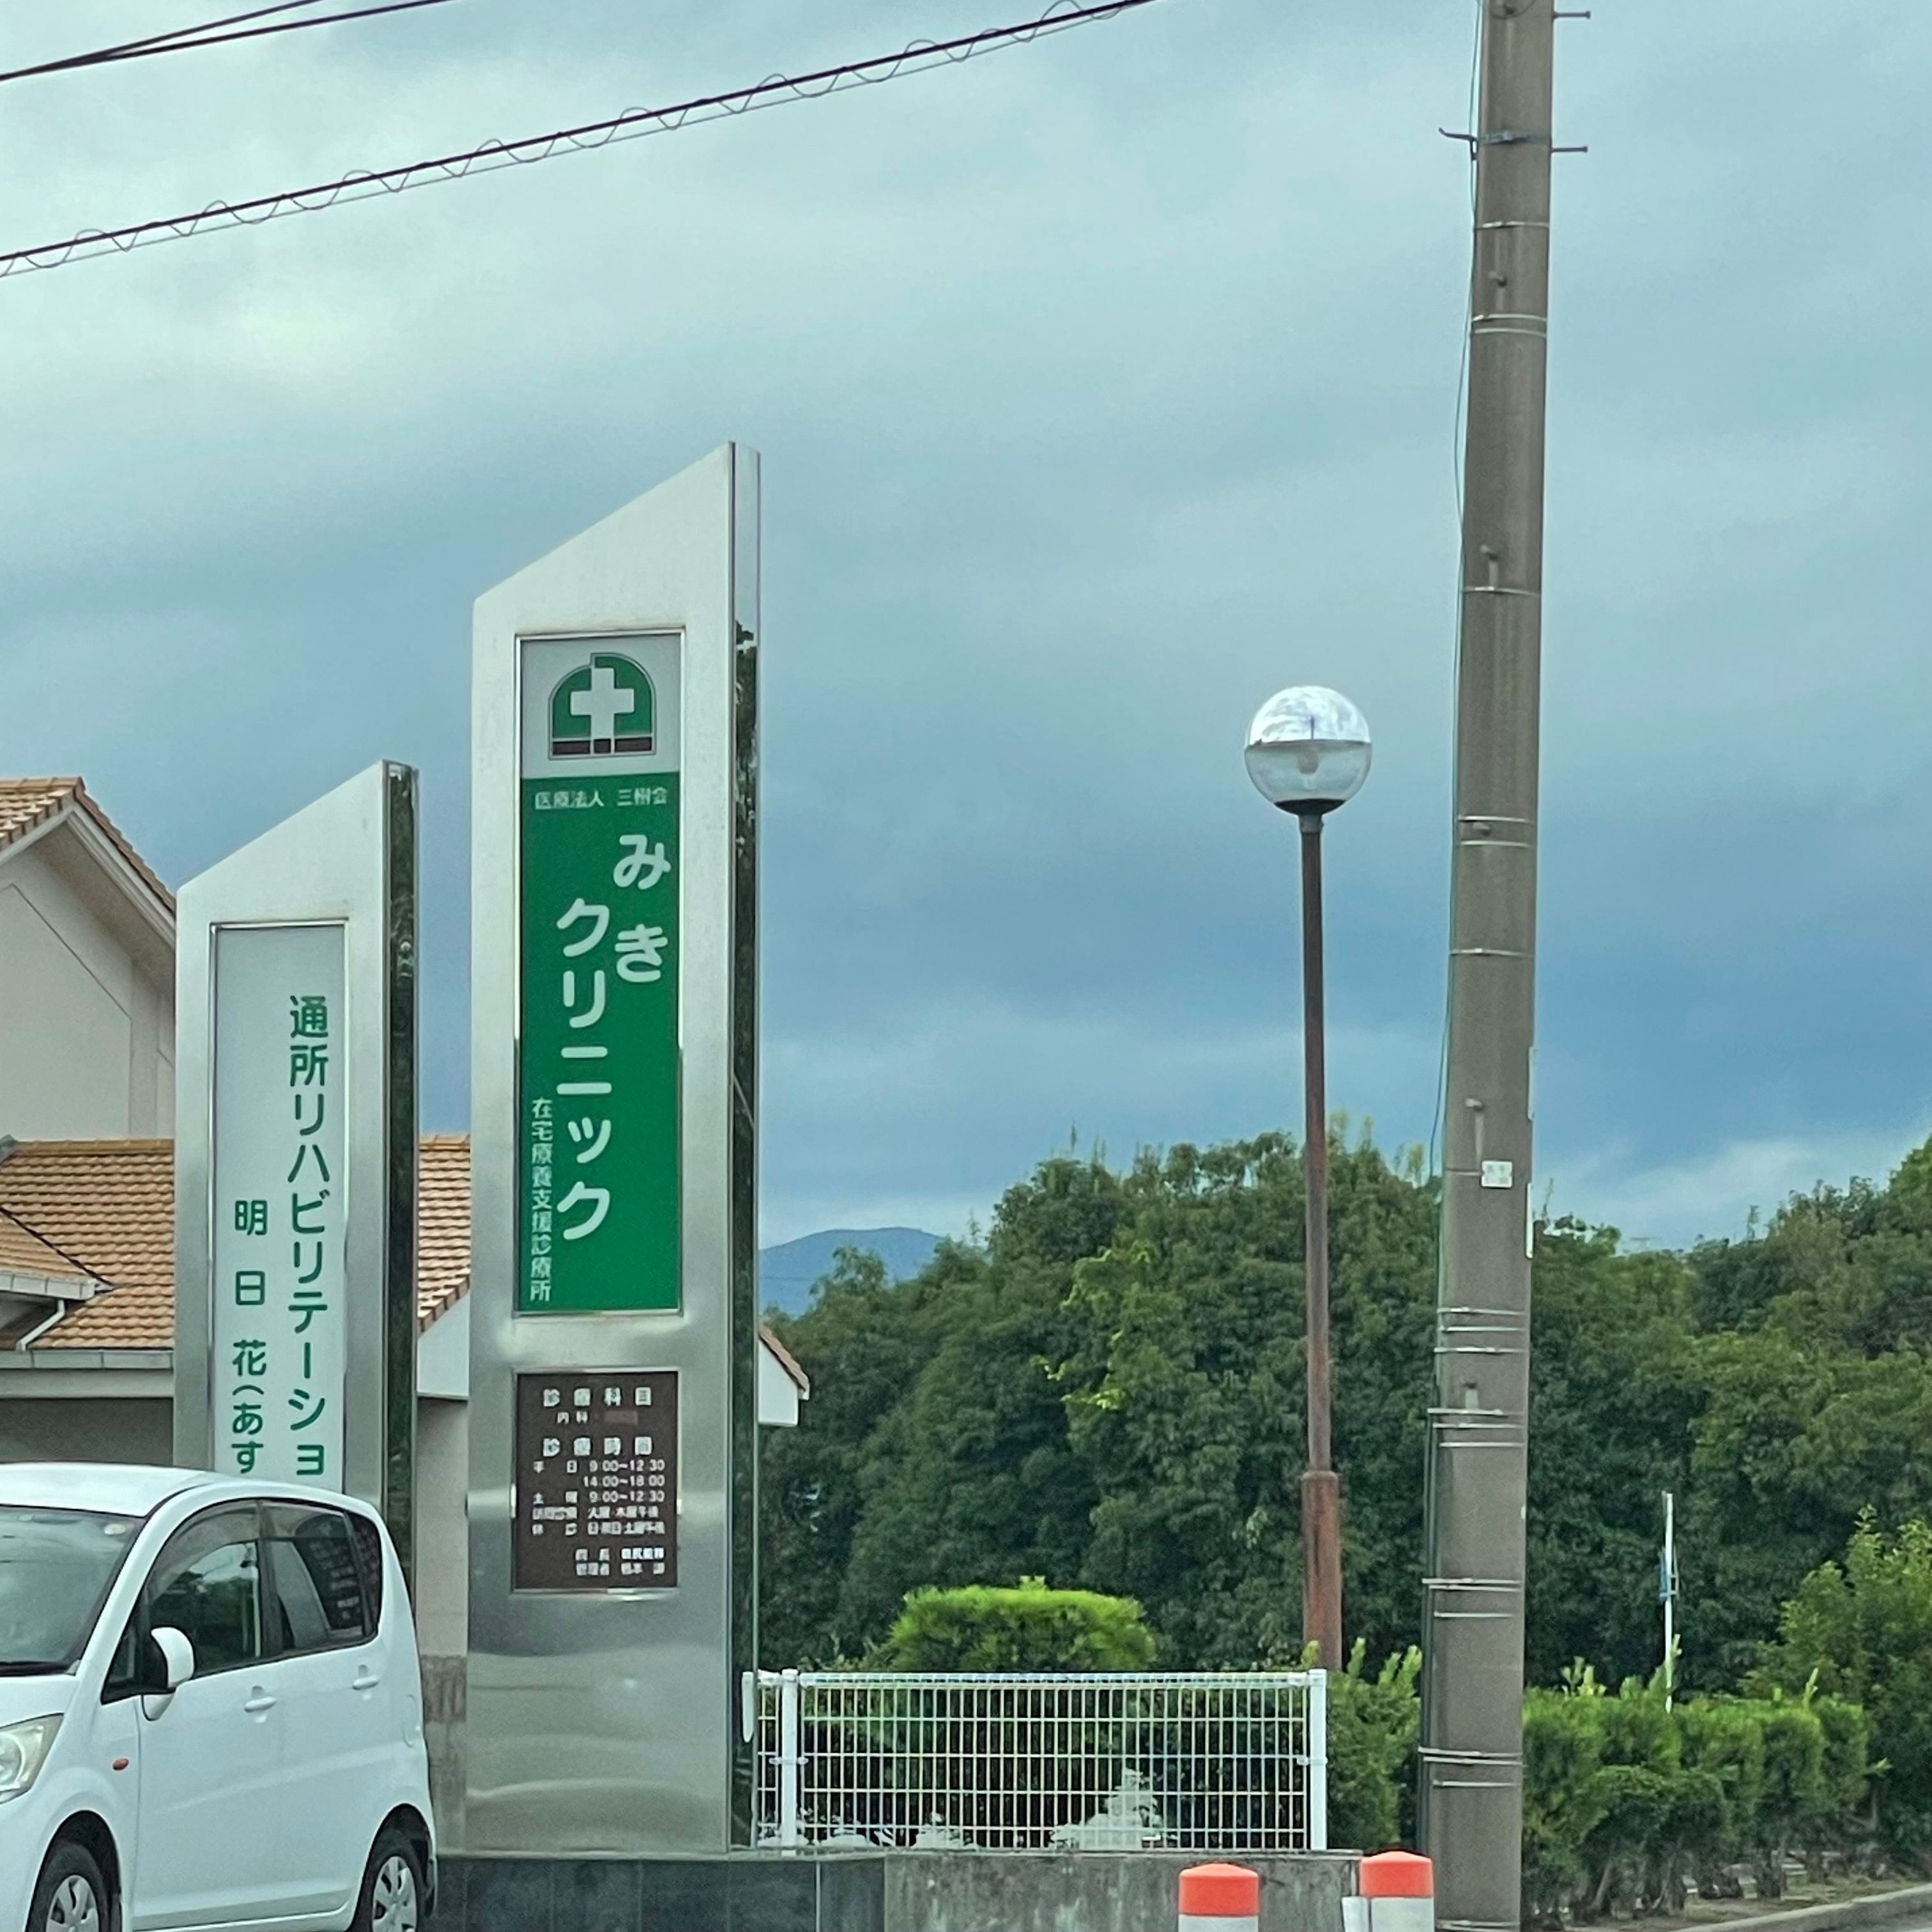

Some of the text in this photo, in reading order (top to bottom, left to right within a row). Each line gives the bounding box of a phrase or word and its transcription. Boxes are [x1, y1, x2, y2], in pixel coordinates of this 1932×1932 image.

[613, 834, 671, 983] みき
[556, 898, 612, 1239] クリニック
